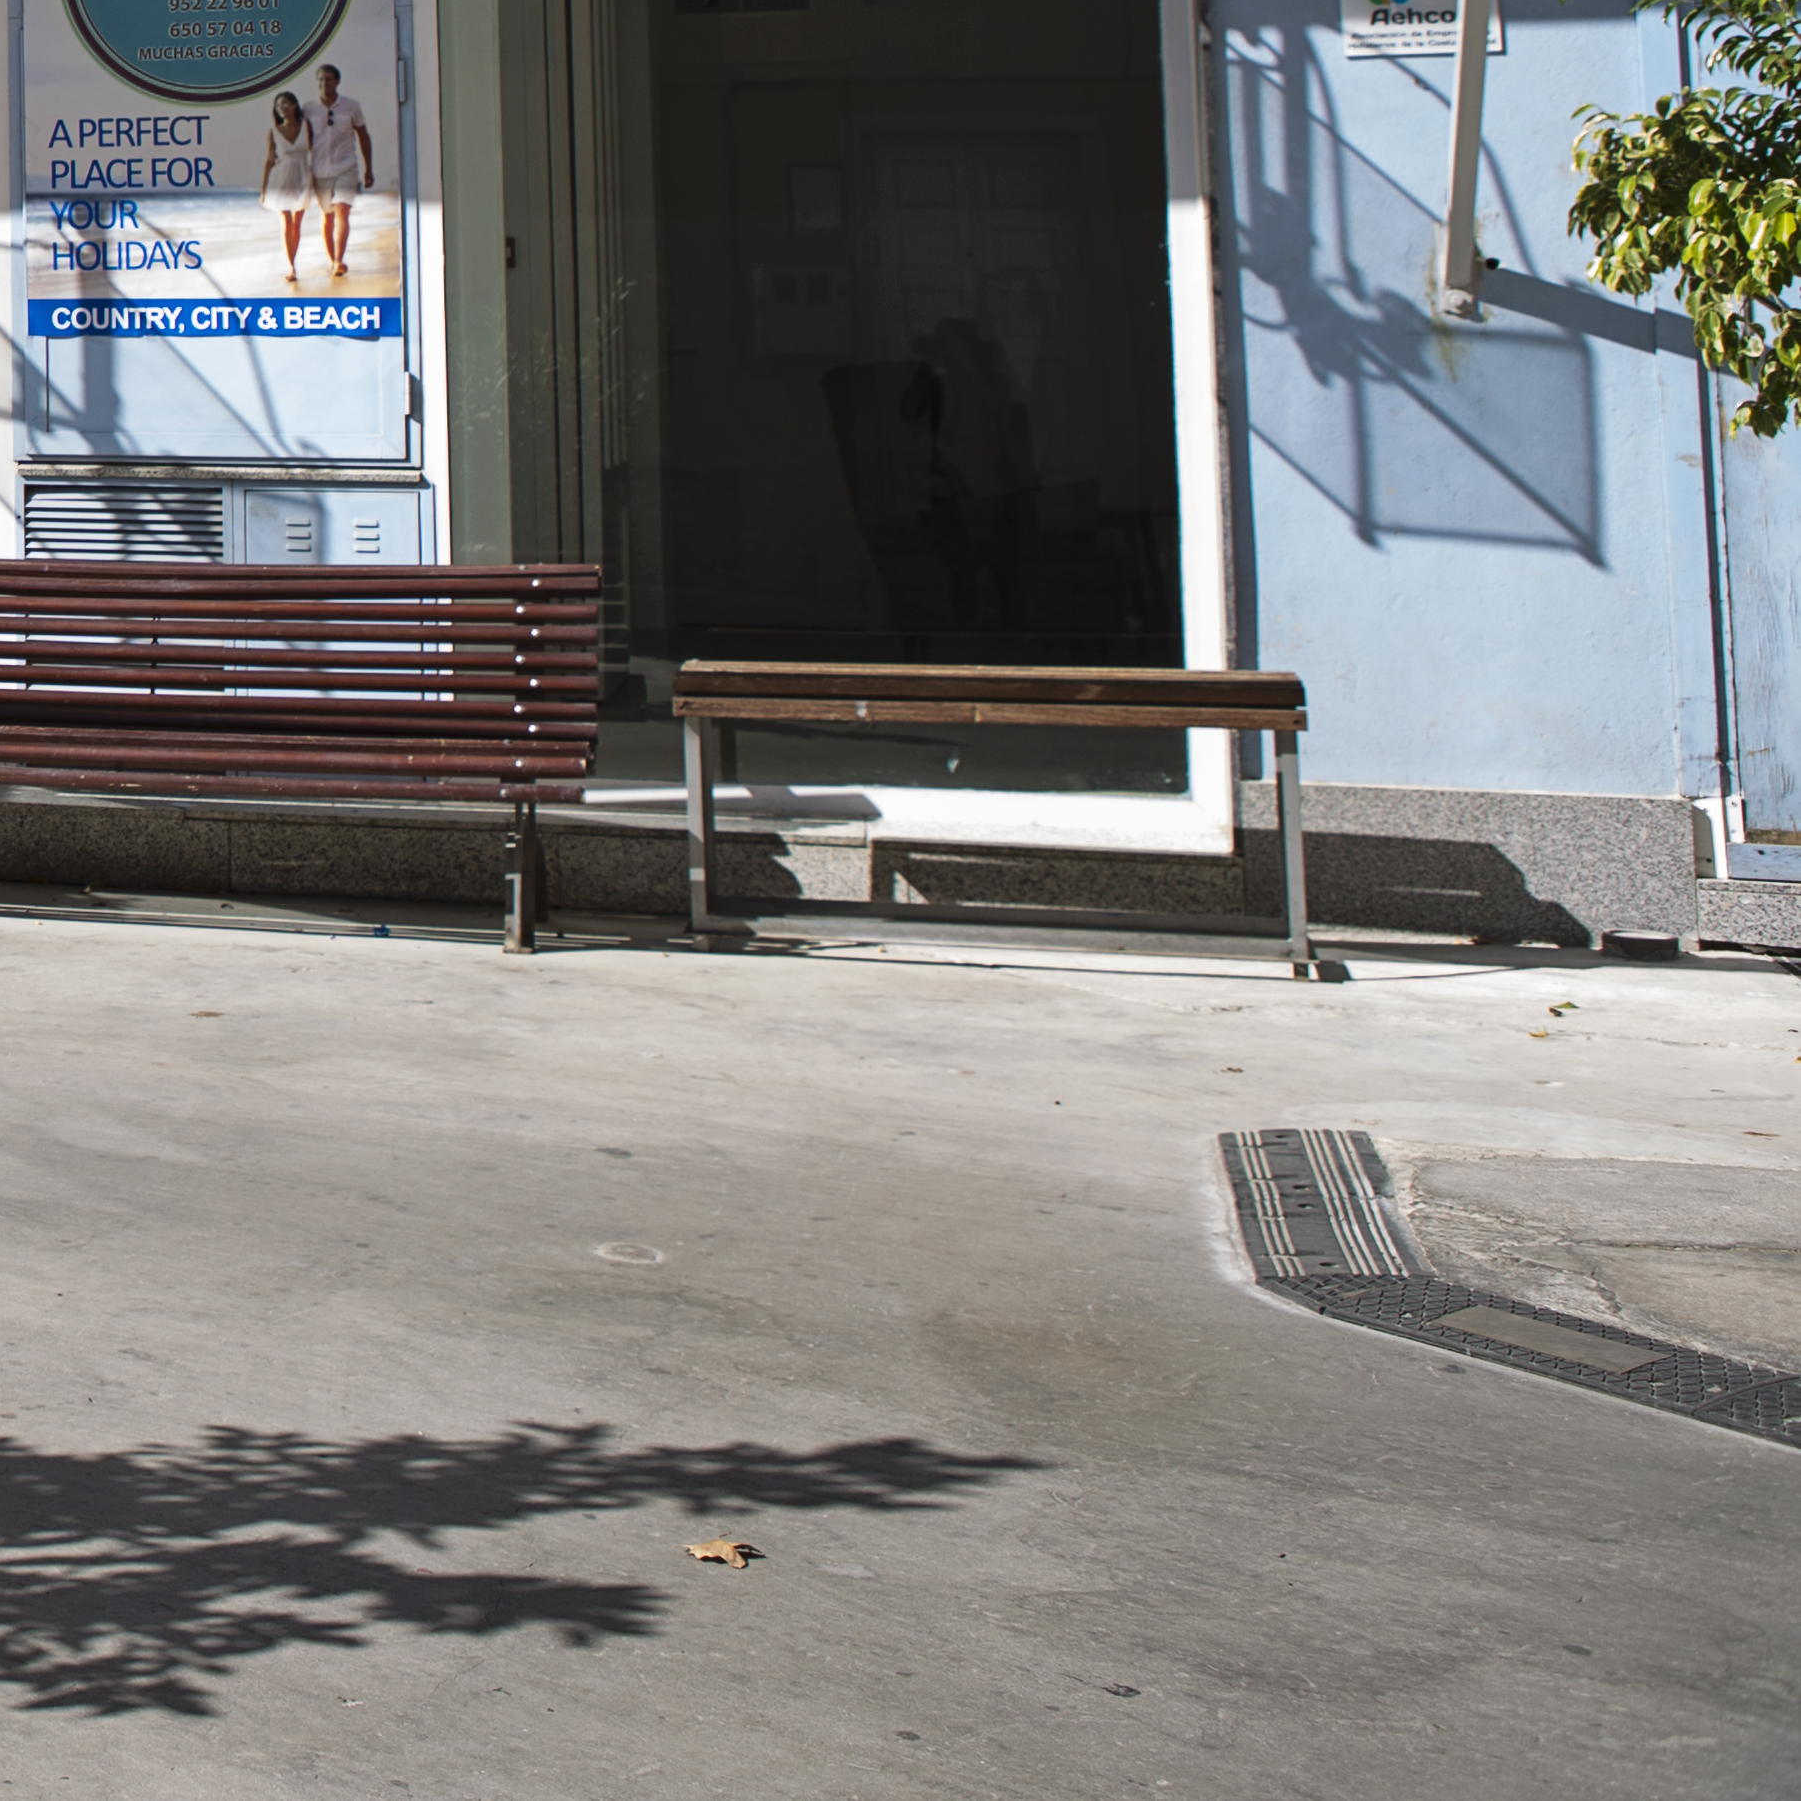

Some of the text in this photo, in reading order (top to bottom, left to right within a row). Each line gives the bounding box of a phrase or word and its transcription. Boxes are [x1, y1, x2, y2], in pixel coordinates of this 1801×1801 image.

[169, 19, 281, 38] 650 57 04 18
[1370, 7, 1457, 26] Aehco
[138, 44, 274, 61] MUCHAS GRACIAS
[48, 115, 210, 148] A PERFECT
[50, 157, 215, 189] PLACE FOR
[49, 200, 139, 230] YOUR
[52, 240, 203, 271] HOLIDAYS
[51, 305, 381, 333] COUNTRY, CITY & BEACH
